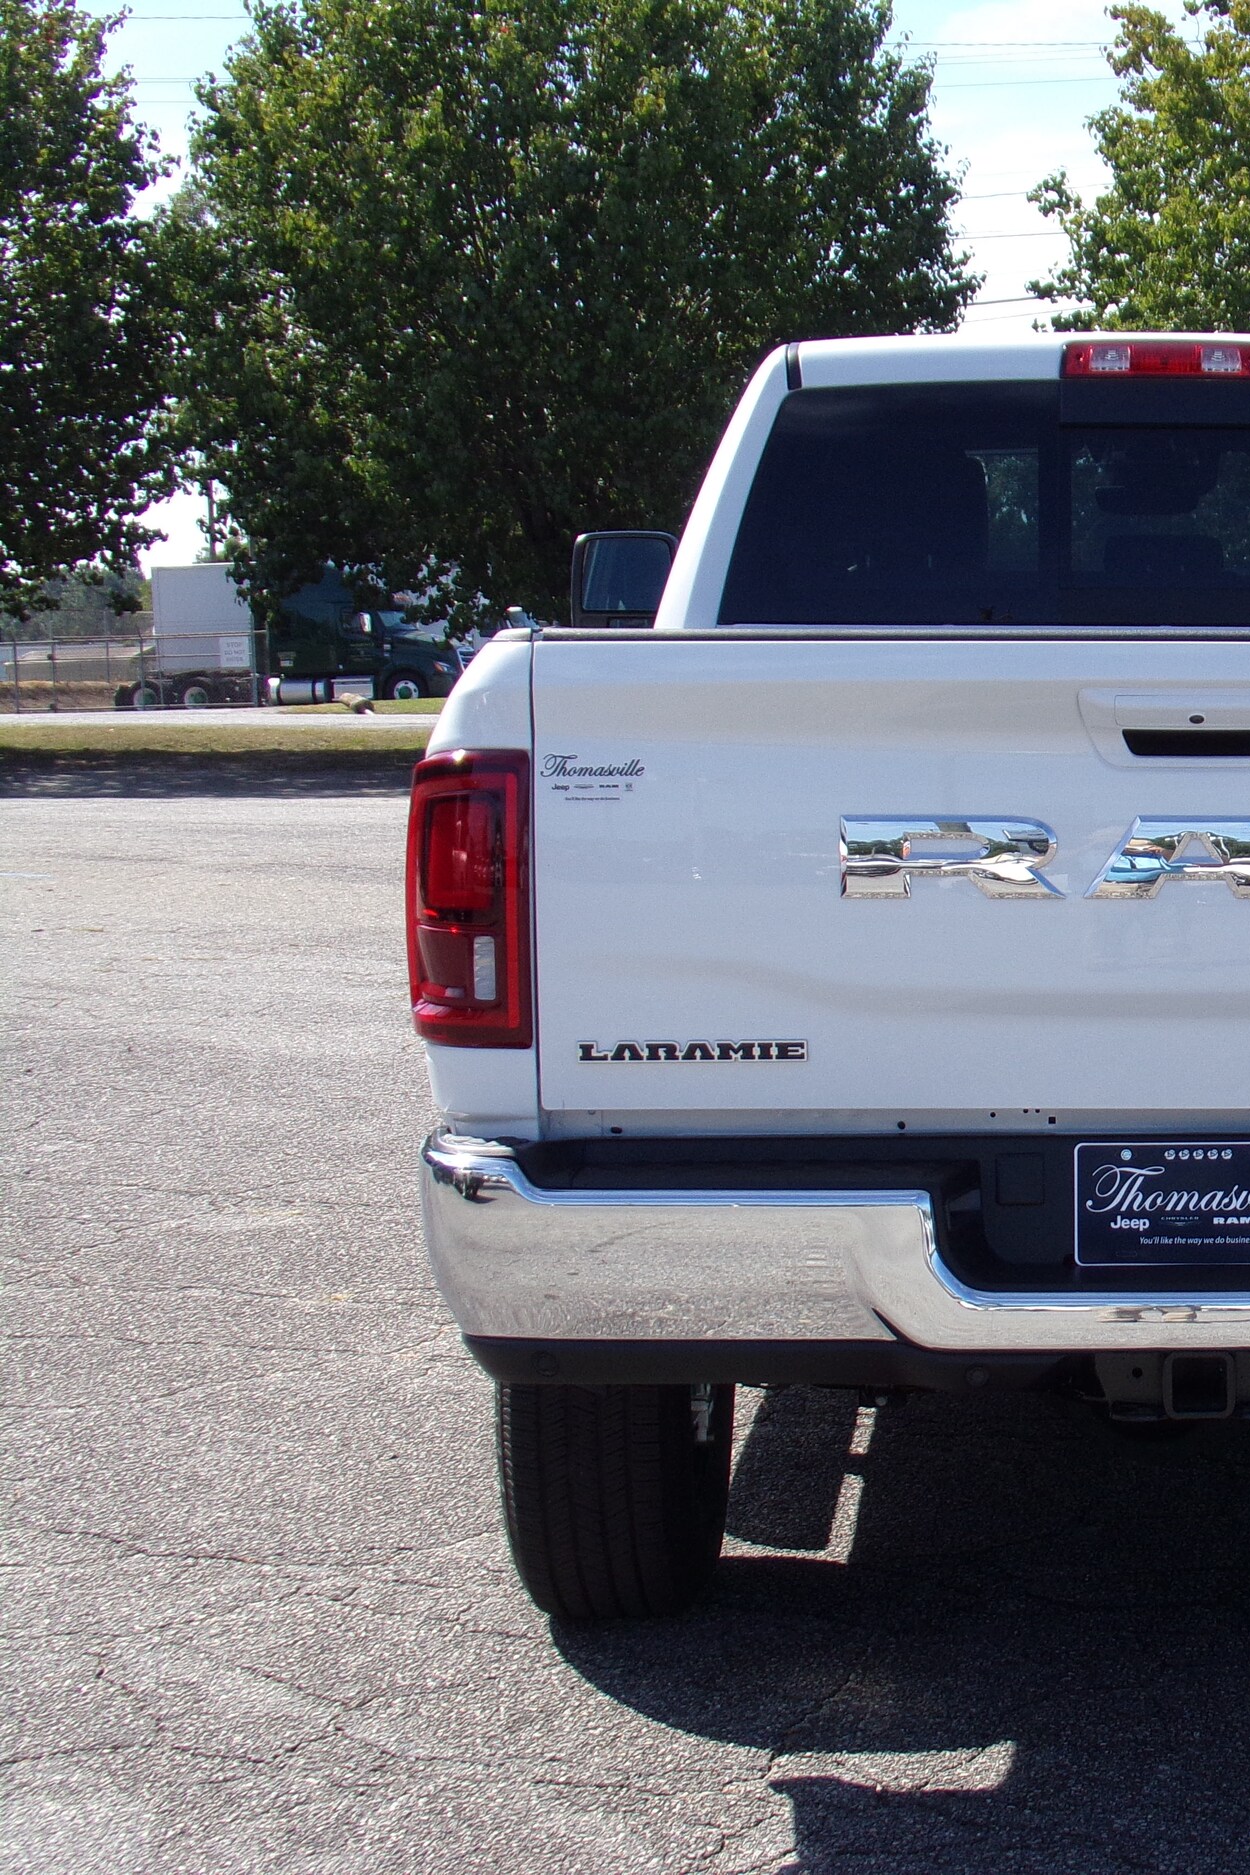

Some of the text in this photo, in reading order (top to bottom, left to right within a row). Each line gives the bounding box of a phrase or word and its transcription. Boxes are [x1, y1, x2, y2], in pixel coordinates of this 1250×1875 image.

[540, 753, 645, 777] Thomasville
[551, 783, 570, 791] Jeep
[577, 1040, 807, 1062] LARAMIE
[1110, 1215, 1150, 1231] Jeep
[1139, 1236, 1160, 1245] You'll
[1160, 1236, 1174, 1244] like
[1174, 1236, 1187, 1244] the
[1187, 1238, 1203, 1246] way
[1215, 1235, 1225, 1244] do
